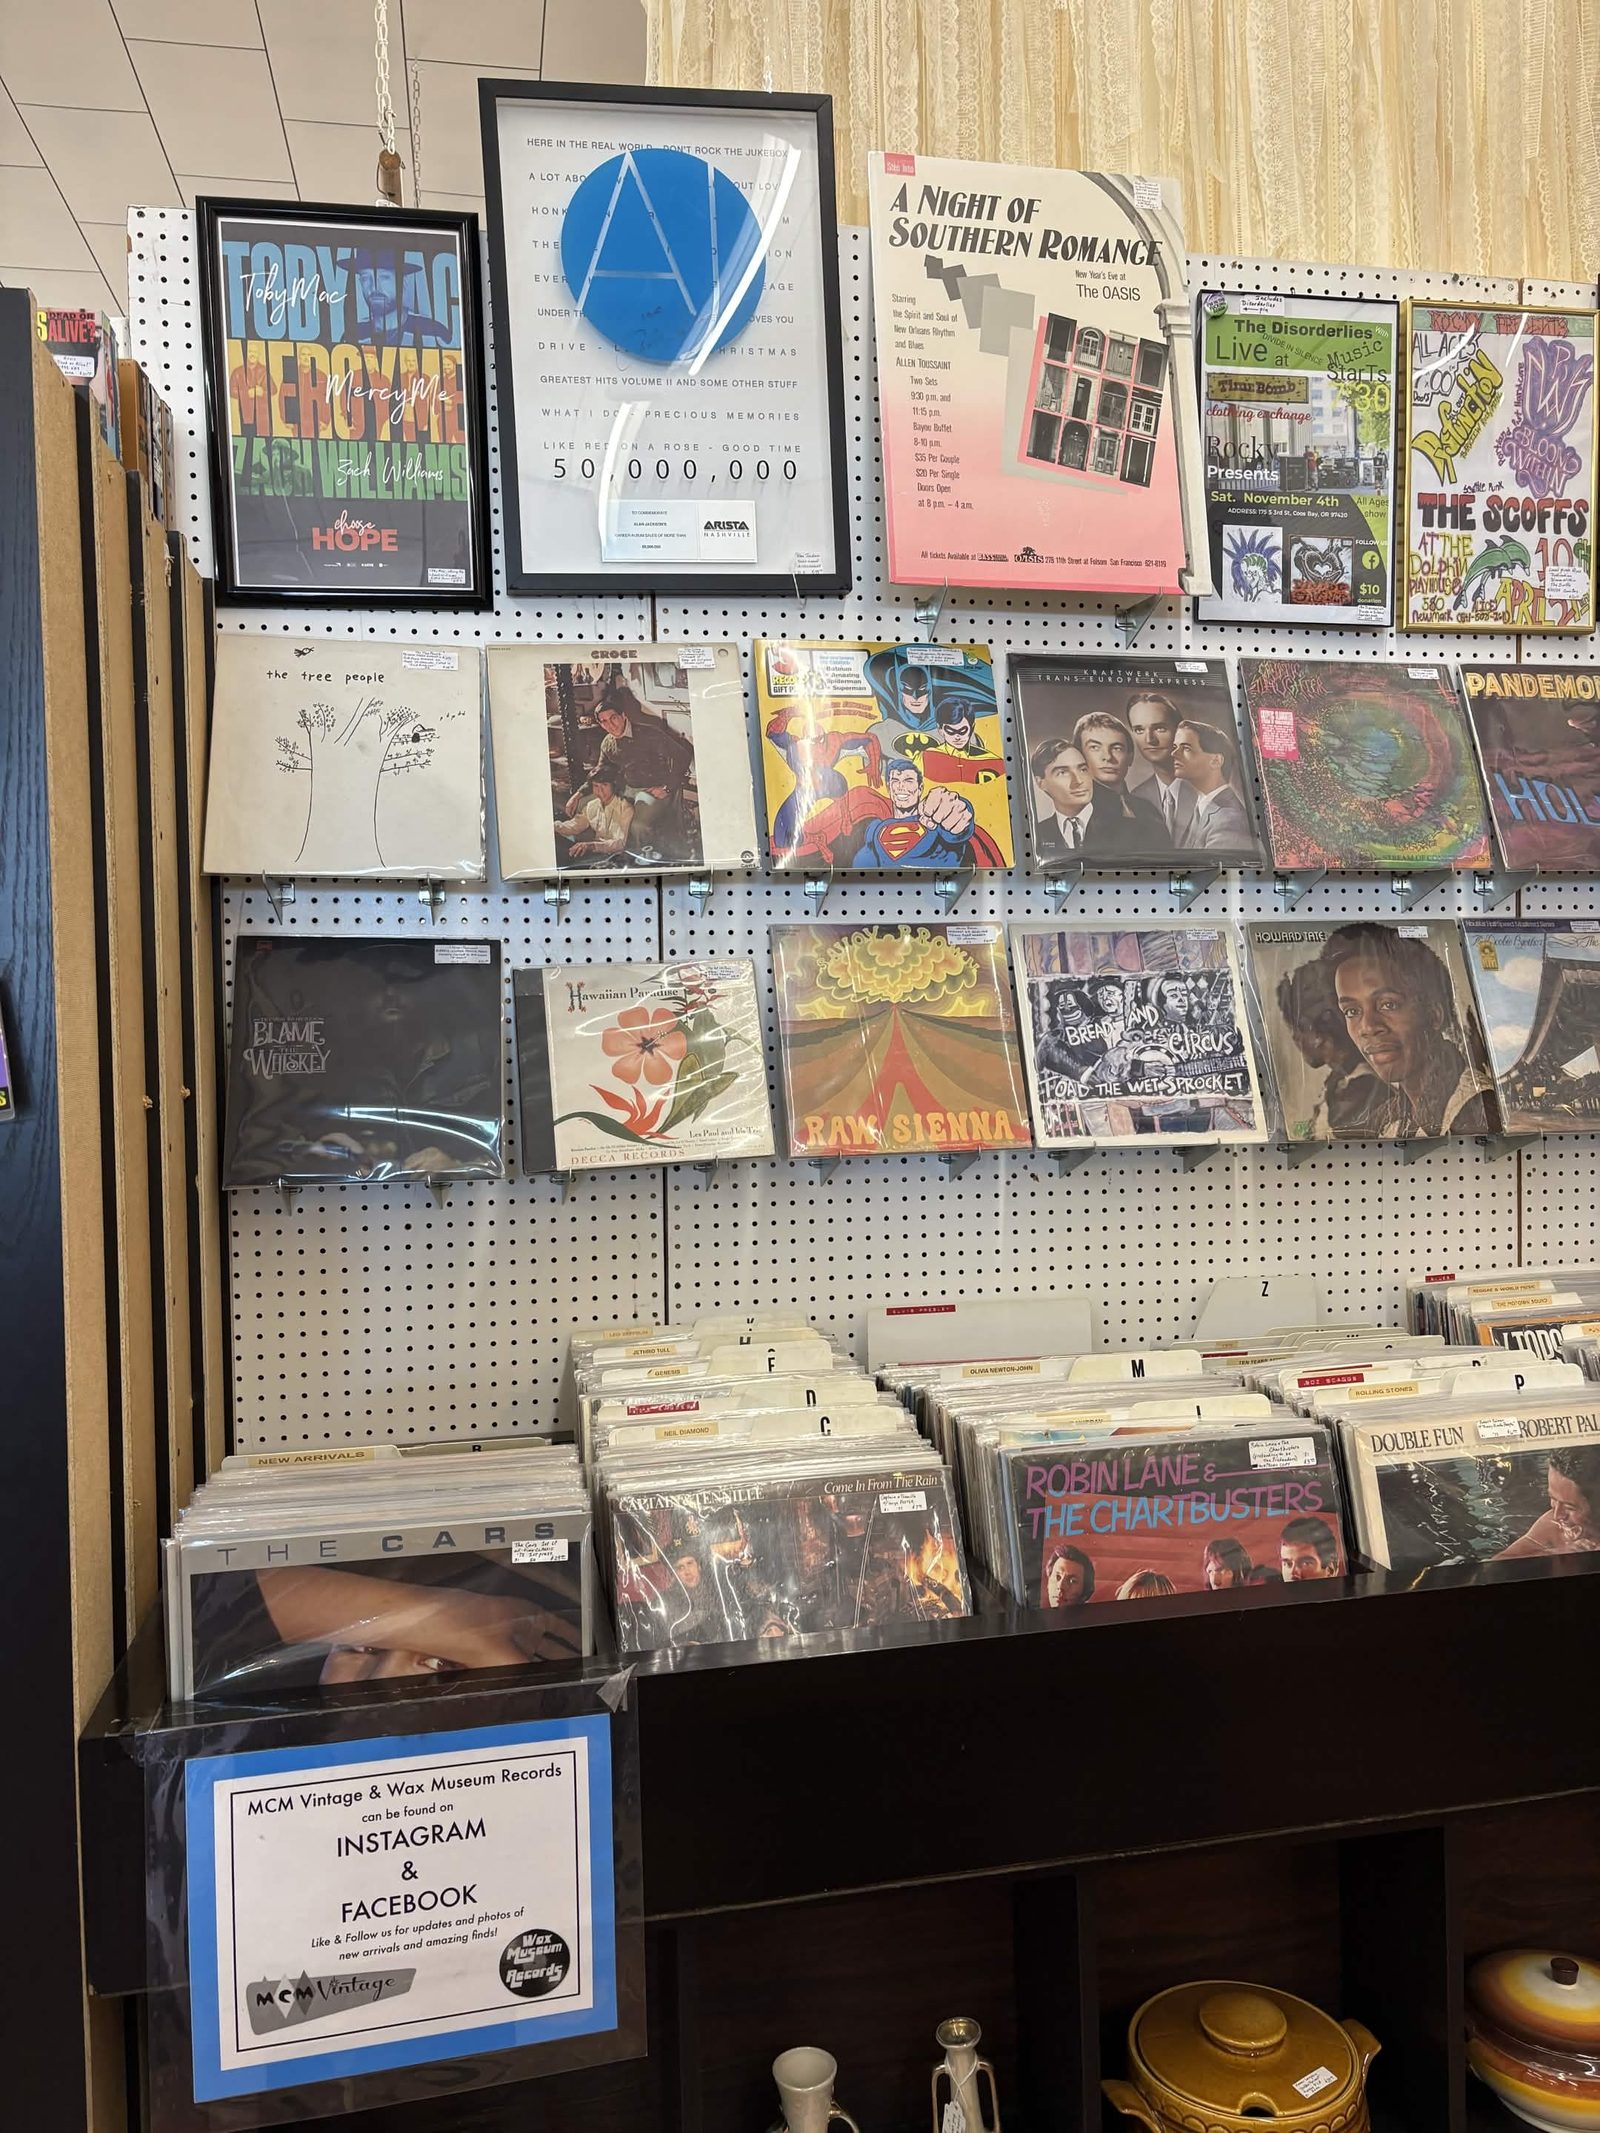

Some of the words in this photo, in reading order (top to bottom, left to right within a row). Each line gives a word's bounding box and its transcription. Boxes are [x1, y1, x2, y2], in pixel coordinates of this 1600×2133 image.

[527, 137, 553, 148] HERE
[555, 138, 567, 148] IN
[569, 139, 588, 149] THE
[591, 140, 616, 151] REAL
[695, 145, 721, 156] ROCK
[724, 146, 742, 157] THE
[745, 147, 788, 158] JUKEBOX
[889, 182, 908, 214] A
[1006, 196, 1042, 224] OF
[891, 293, 916, 305] Starring
[1076, 283, 1099, 299] The
[1102, 284, 1141, 302] OASIS
[50, 312, 76, 321] DEAD
[79, 312, 95, 320] OR
[47, 318, 96, 343] ALIVE?
[1234, 319, 1266, 334] The
[1271, 321, 1373, 341] Disorderlies
[538, 341, 586, 351] DRIVE
[1215, 335, 1268, 363] Live
[1327, 337, 1384, 366] Music
[896, 356, 916, 368] ALLEN
[917, 357, 951, 371] TOUSSAINT
[1275, 353, 1289, 367] at
[540, 375, 591, 386] GREATEST
[595, 376, 618, 386] HITS
[621, 377, 663, 387] VOLUME
[665, 378, 673, 387] II
[676, 378, 697, 388] AND
[699, 378, 728, 388] SOME
[731, 379, 764, 389] OTHER
[767, 379, 798, 390] STUFF
[326, 370, 456, 425] MercyMe
[542, 408, 580, 418] WHAT
[644, 410, 718, 420] PRECIOUS
[726, 411, 801, 422] MEMORIES
[1206, 406, 1255, 423] clothing
[1256, 409, 1313, 424] exchange
[664, 442, 700, 452] ROSE
[722, 443, 760, 454] GOOD
[769, 443, 801, 454] TIME
[1206, 435, 1280, 465] Rocky
[336, 452, 371, 486] Zach
[382, 453, 445, 485] Williams
[553, 457, 798, 484] 50,000,000
[1207, 464, 1279, 482] Presents
[1211, 491, 1236, 503] Sat.
[1243, 492, 1313, 507] November
[1316, 495, 1340, 507] 4th
[335, 509, 376, 531] choose
[1364, 509, 1387, 519] show
[1417, 492, 1475, 532] THE
[1483, 498, 1590, 538] SCOFFS
[703, 520, 750, 531] ARISTA
[312, 526, 399, 553] HOPE
[1418, 532, 1439, 556] AT
[1439, 534, 1474, 557] THE
[1359, 583, 1380, 596] $10
[591, 649, 638, 659] CROCE
[266, 669, 289, 680] the
[301, 671, 332, 683] tree
[345, 672, 385, 688] people
[1084, 668, 1159, 678] KRAFTWERK
[1150, 678, 1206, 687] EXPRESS
[773, 686, 788, 694] GIFT
[816, 925, 879, 970] SAVOY
[1255, 931, 1302, 943] HOWARD
[1302, 931, 1326, 942] TATE
[565, 981, 627, 1013] Hawaiian
[630, 986, 679, 998] Paradise
[1126, 1004, 1159, 1028] AND
[252, 1019, 326, 1047] BLAME
[1065, 1023, 1112, 1046] BREAD
[1169, 1031, 1234, 1055] CIRCUS
[243, 1043, 331, 1081] WHISKEY
[1038, 1076, 1090, 1098] TOAD
[1095, 1081, 1123, 1095] THE
[1127, 1079, 1158, 1094] WET
[1160, 1073, 1244, 1094] SPROCKET
[804, 1113, 879, 1147] RAW
[892, 1110, 1016, 1143] SIENNA
[571, 1154, 617, 1166] DECCA
[623, 1148, 686, 1162] RECORDS
[1261, 1281, 1270, 1297] Z
[632, 1348, 656, 1356] JETHRO
[657, 1347, 671, 1355] TULL
[989, 1365, 1033, 1375] NEWTON-JOHN
[1131, 1359, 1145, 1378] M
[1356, 1388, 1383, 1396] ROLLING
[1384, 1386, 1413, 1394] STONES
[1515, 1374, 1525, 1391] P
[679, 1426, 710, 1436] DIAMOND
[820, 1415, 832, 1436] C
[1518, 1415, 1572, 1438] ROBERT
[1371, 1430, 1432, 1453] DOUBLE
[1434, 1426, 1465, 1446] FUN
[258, 1456, 290, 1466] NEW
[293, 1451, 366, 1464] ARRIVALS
[824, 1479, 853, 1494] Come
[855, 1478, 865, 1491] In
[867, 1477, 891, 1491] From
[893, 1475, 914, 1489] The
[916, 1473, 938, 1487] Rain
[1026, 1460, 1118, 1500] ROBIN
[1124, 1453, 1199, 1491] LANE
[1026, 1503, 1086, 1540] THE
[1089, 1481, 1324, 1533] CHARTBUSTERS
[218, 1540, 338, 1566] THE
[381, 1521, 555, 1553] CARS
[247, 1795, 294, 1817] MCM
[300, 1787, 363, 1812] Vintage
[369, 1784, 382, 1800] &
[387, 1779, 425, 1797] Wax
[431, 1771, 496, 1792] Museum
[501, 1763, 562, 1784] Records
[361, 1813, 382, 1824] can
[385, 1807, 400, 1821] be
[403, 1803, 437, 1818] found
[439, 1803, 454, 1814] on
[336, 1818, 486, 1858] INSTAGRAM
[400, 1859, 419, 1882] &
[340, 1883, 478, 1924] FACEBOOK
[311, 1933, 331, 1949] Like
[345, 1927, 379, 1943] Follow
[381, 1927, 393, 1938] us
[394, 1922, 410, 1937] for
[412, 1917, 453, 1937] updates
[455, 1913, 474, 1928] and
[477, 1909, 511, 1930] photos
[513, 1906, 526, 1920] of
[339, 1950, 361, 1961] new
[362, 1941, 401, 1958] arrivals
[403, 1938, 423, 1952] and
[426, 1933, 469, 1954] amazing
[472, 1926, 499, 1943] finds!
[521, 1933, 552, 1947] Wax
[506, 1941, 563, 1963] Museum
[505, 1963, 563, 1988] Records
[256, 1986, 314, 2007] MCM
[318, 1975, 396, 2001] Vintage
